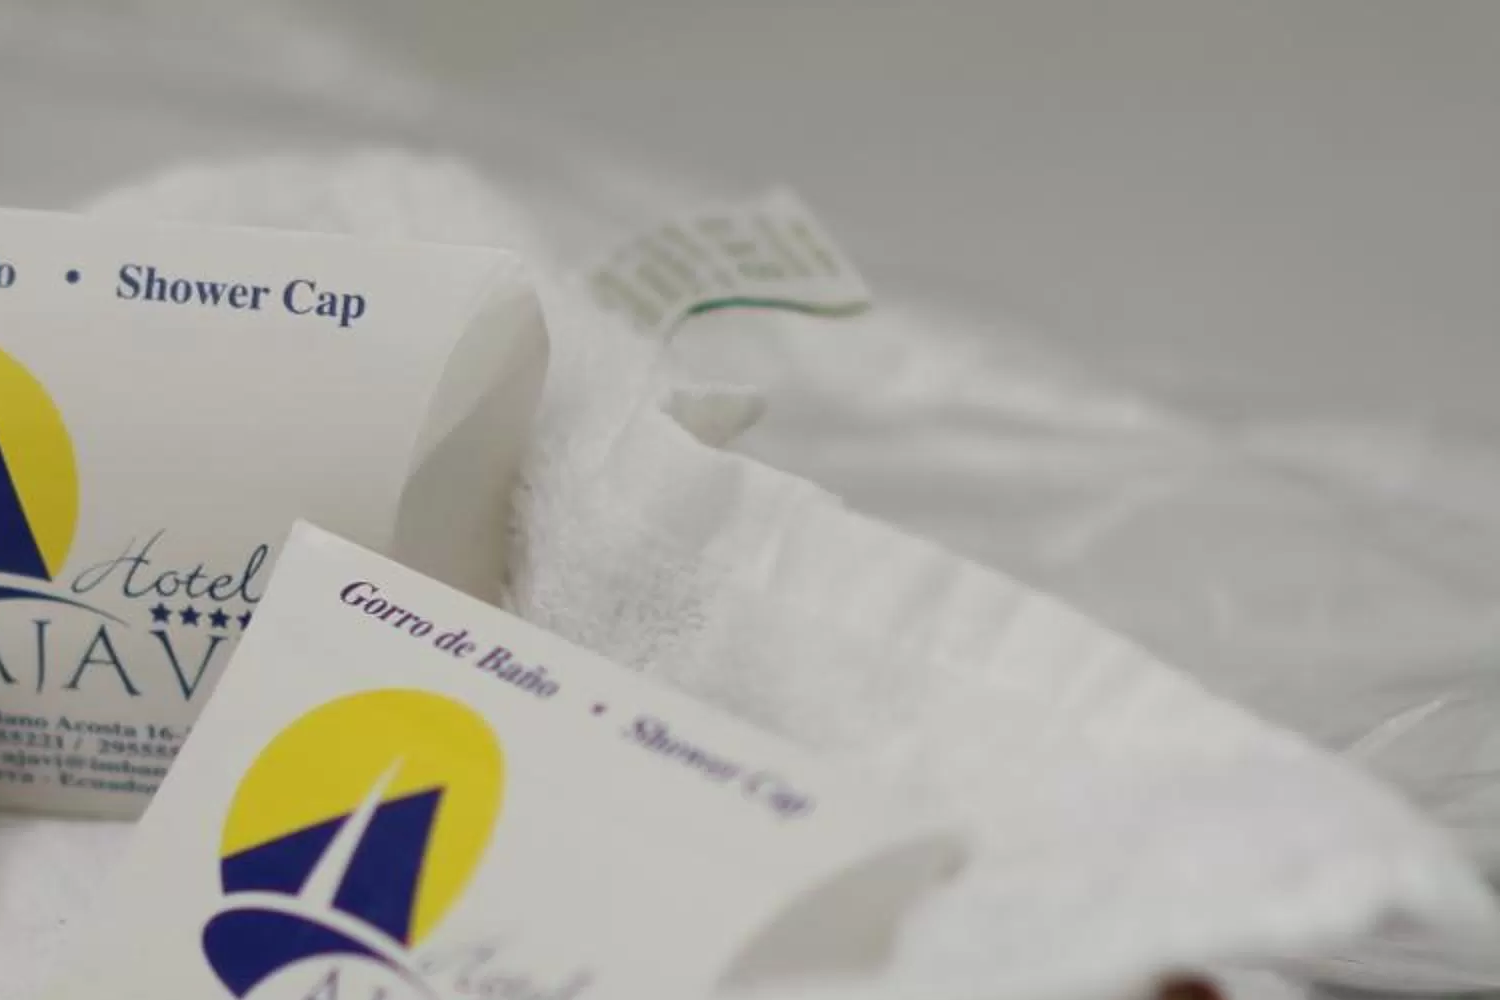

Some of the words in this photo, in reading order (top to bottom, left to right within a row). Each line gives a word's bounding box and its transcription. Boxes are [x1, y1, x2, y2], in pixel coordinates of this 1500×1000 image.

[116, 264, 270, 312] Shower
[282, 279, 367, 328] Cap
[71, 528, 268, 604] Hotel
[338, 579, 435, 640] Gorro
[434, 629, 477, 659] de
[475, 645, 561, 700] Baño
